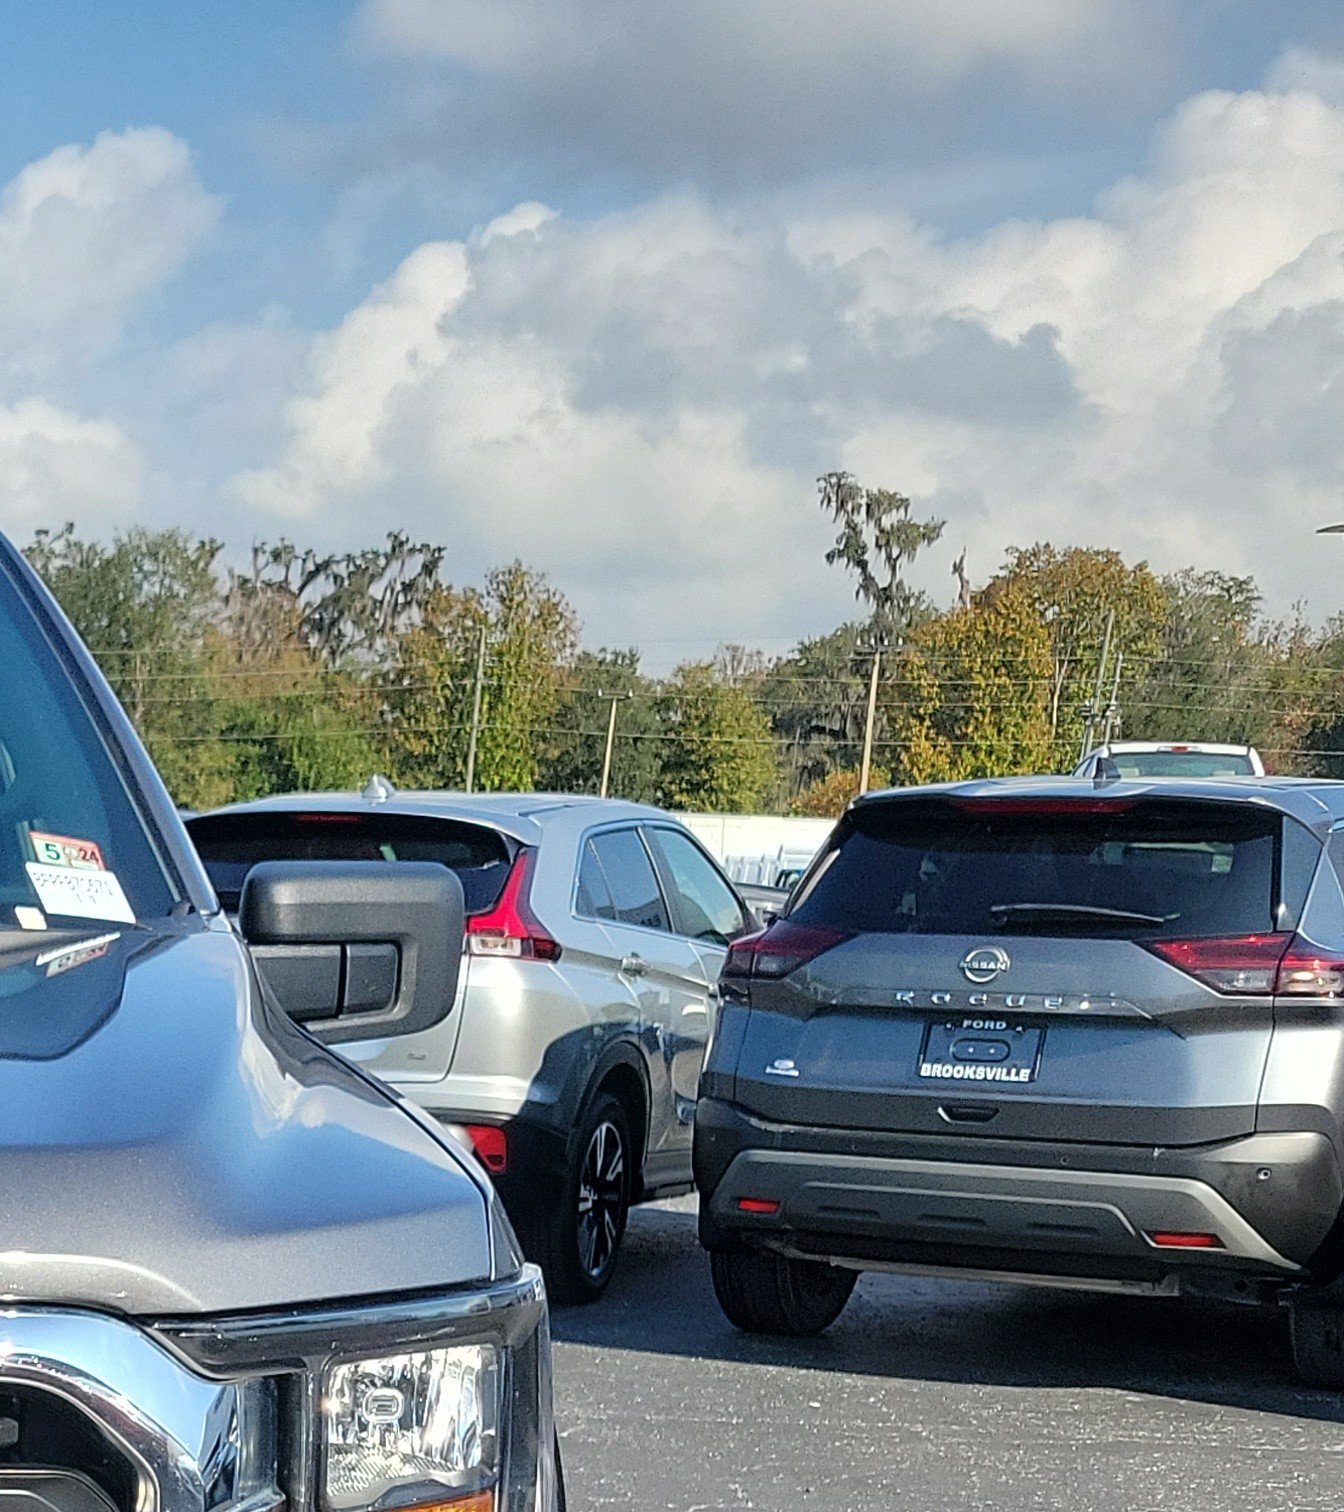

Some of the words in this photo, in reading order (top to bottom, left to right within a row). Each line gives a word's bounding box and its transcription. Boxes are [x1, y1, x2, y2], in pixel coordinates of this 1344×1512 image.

[45, 842, 61, 861] 5
[960, 960, 1010, 971] NISSAN
[896, 990, 1063, 1010] ROGUE
[962, 1018, 1008, 1031] FORD
[920, 1063, 1031, 1083] BROOKSVILLE
